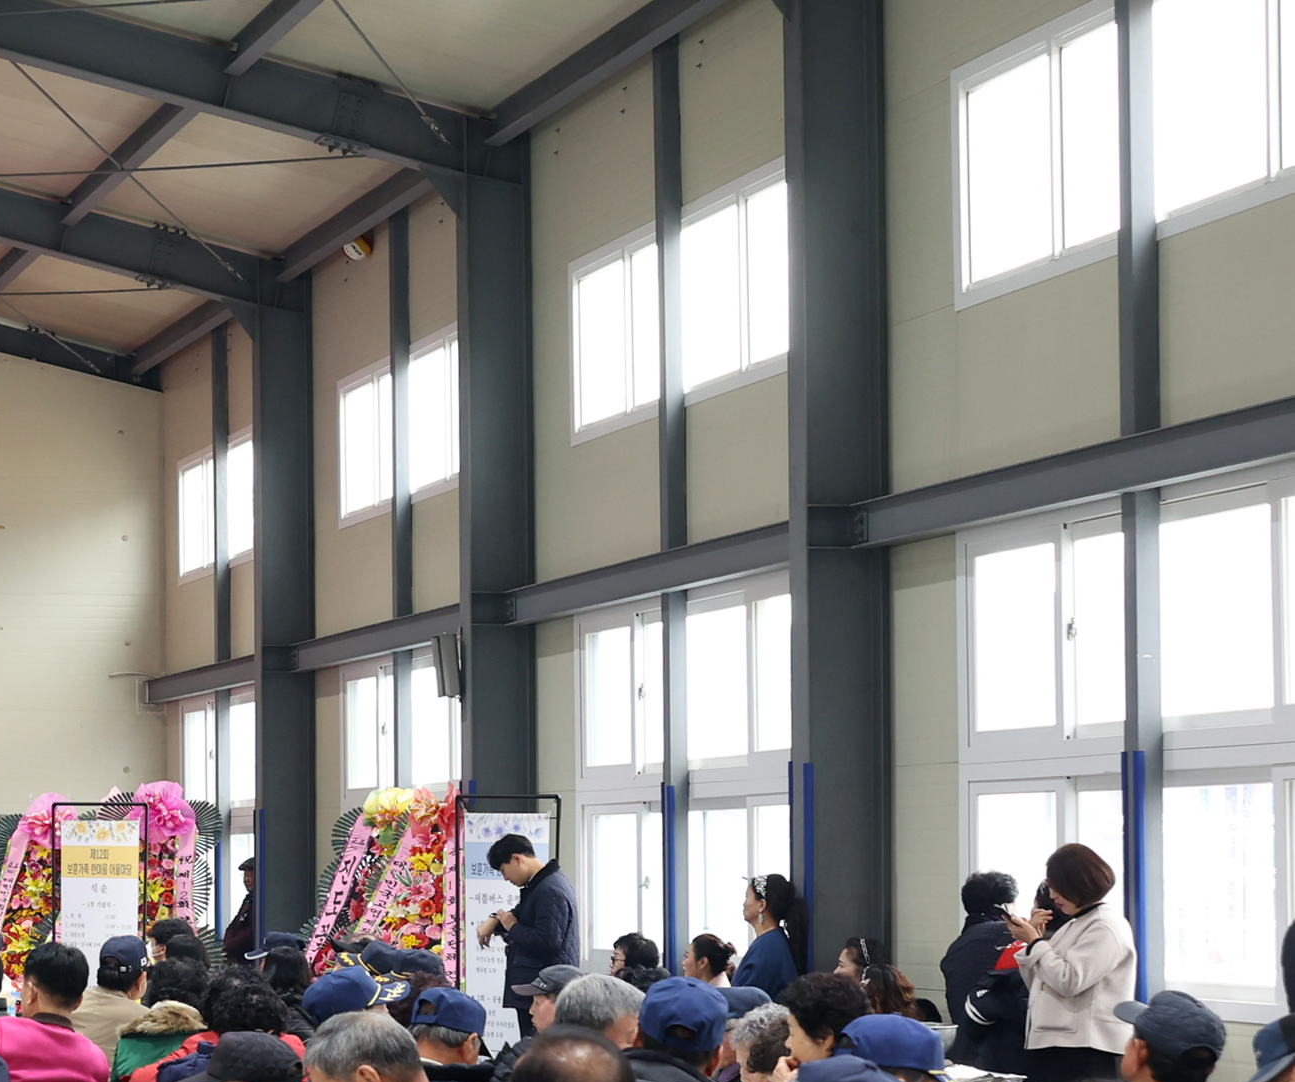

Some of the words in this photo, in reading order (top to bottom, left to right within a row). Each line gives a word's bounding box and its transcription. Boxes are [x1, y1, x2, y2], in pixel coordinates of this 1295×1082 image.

[89, 848, 110, 860] 제12회
[66, 863, 90, 875] 보훈가족
[91, 863, 108, 876] 한마음
[109, 863, 133, 876] 어울마당
